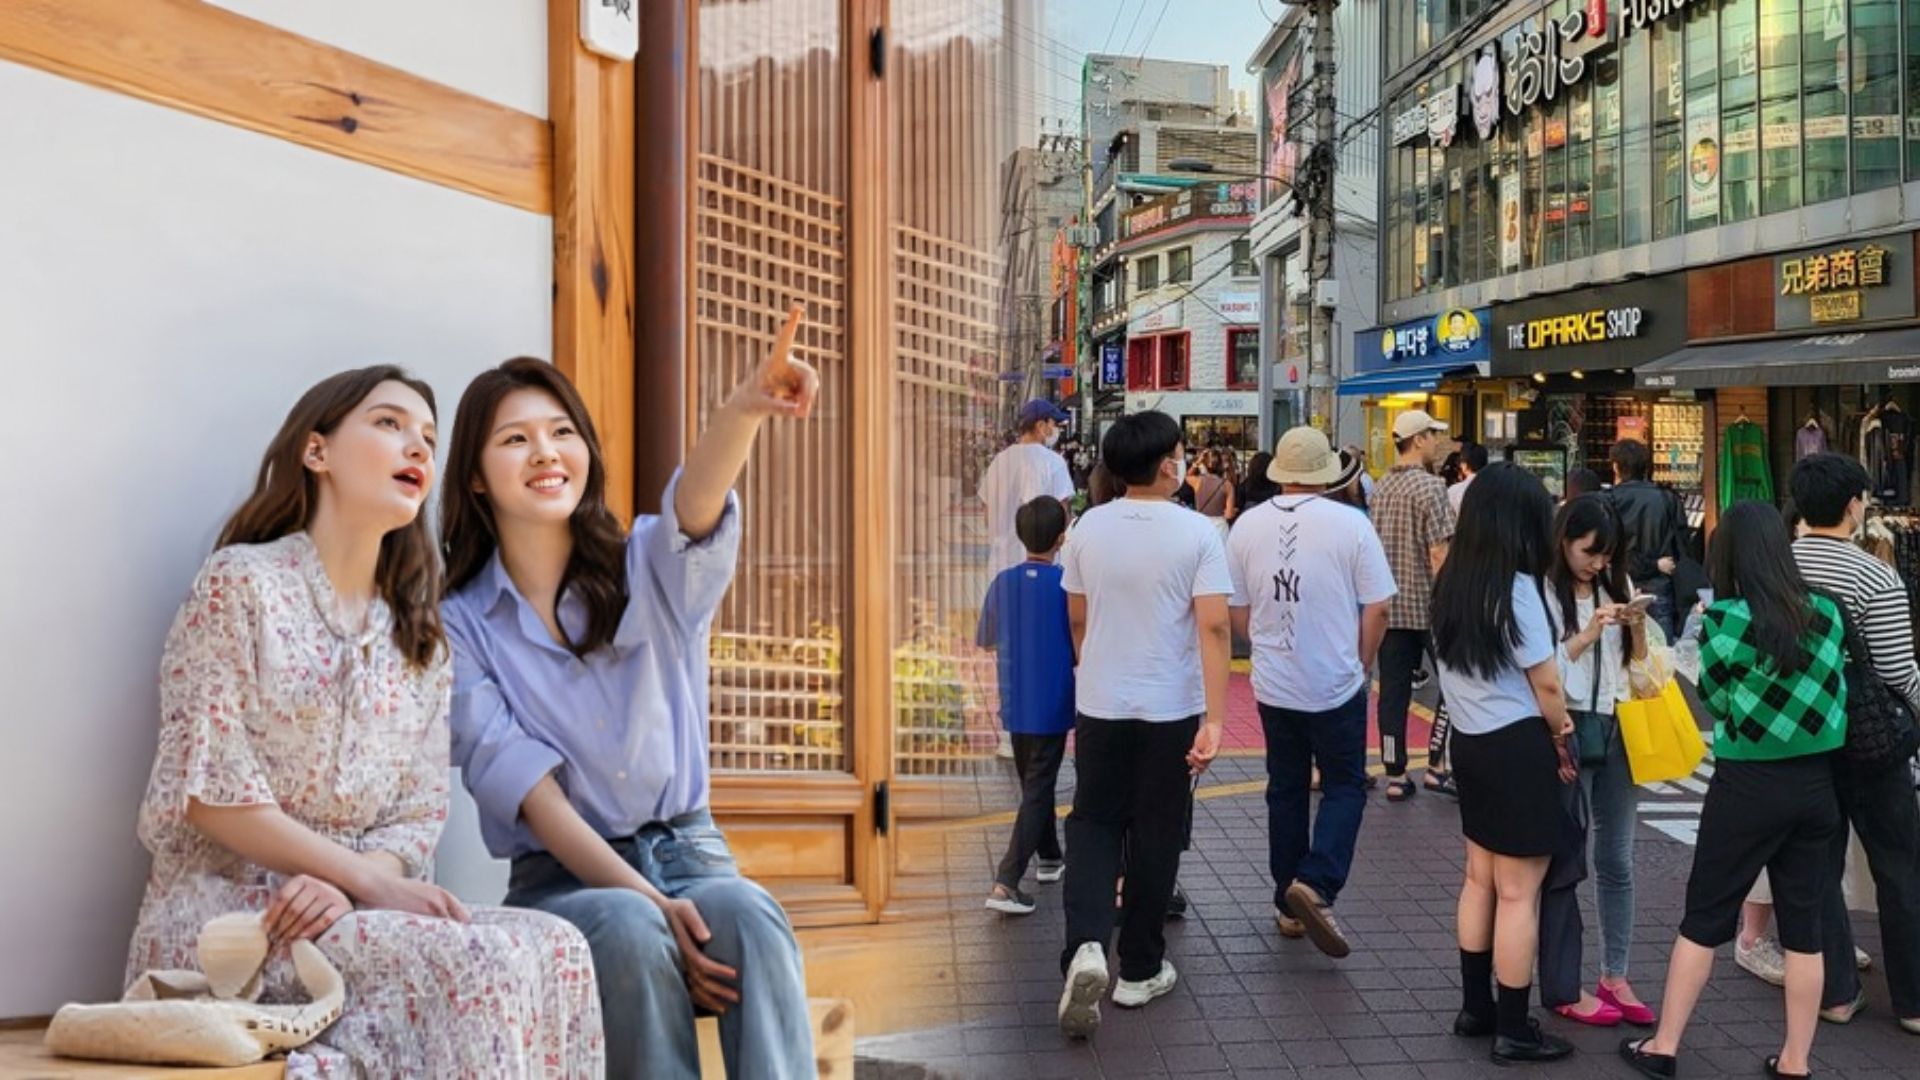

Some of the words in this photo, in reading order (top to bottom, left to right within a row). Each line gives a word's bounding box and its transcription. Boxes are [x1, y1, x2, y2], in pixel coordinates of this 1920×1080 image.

[1781, 244, 1884, 296] 兄弟商會
[1507, 323, 1525, 349] THE
[1607, 307, 1641, 339] SHOP
[1273, 568, 1301, 603] NY
